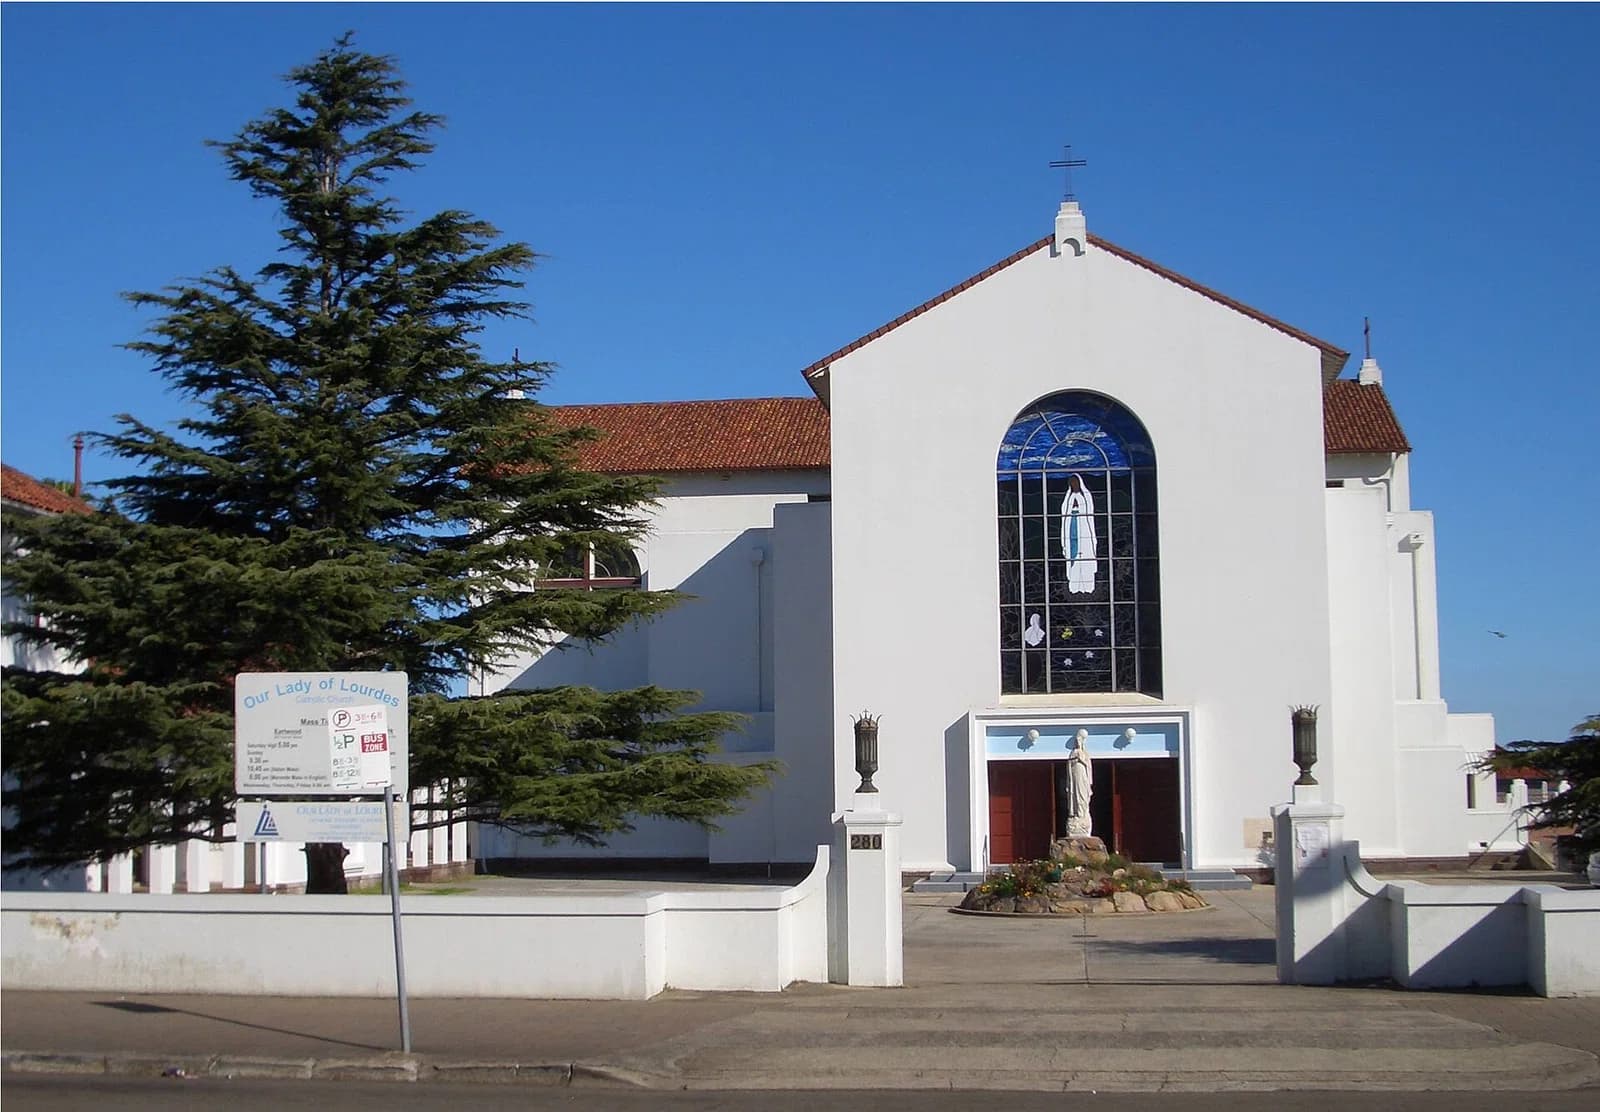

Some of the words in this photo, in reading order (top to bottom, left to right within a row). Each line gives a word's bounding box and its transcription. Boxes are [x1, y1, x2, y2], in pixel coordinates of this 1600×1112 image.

[243, 690, 270, 709] Our
[276, 680, 312, 697] Lady
[318, 677, 335, 690] of
[340, 679, 400, 708] Lourdes
[363, 734, 384, 744] BUS
[364, 743, 385, 751] ZONE
[851, 834, 883, 850] 280
